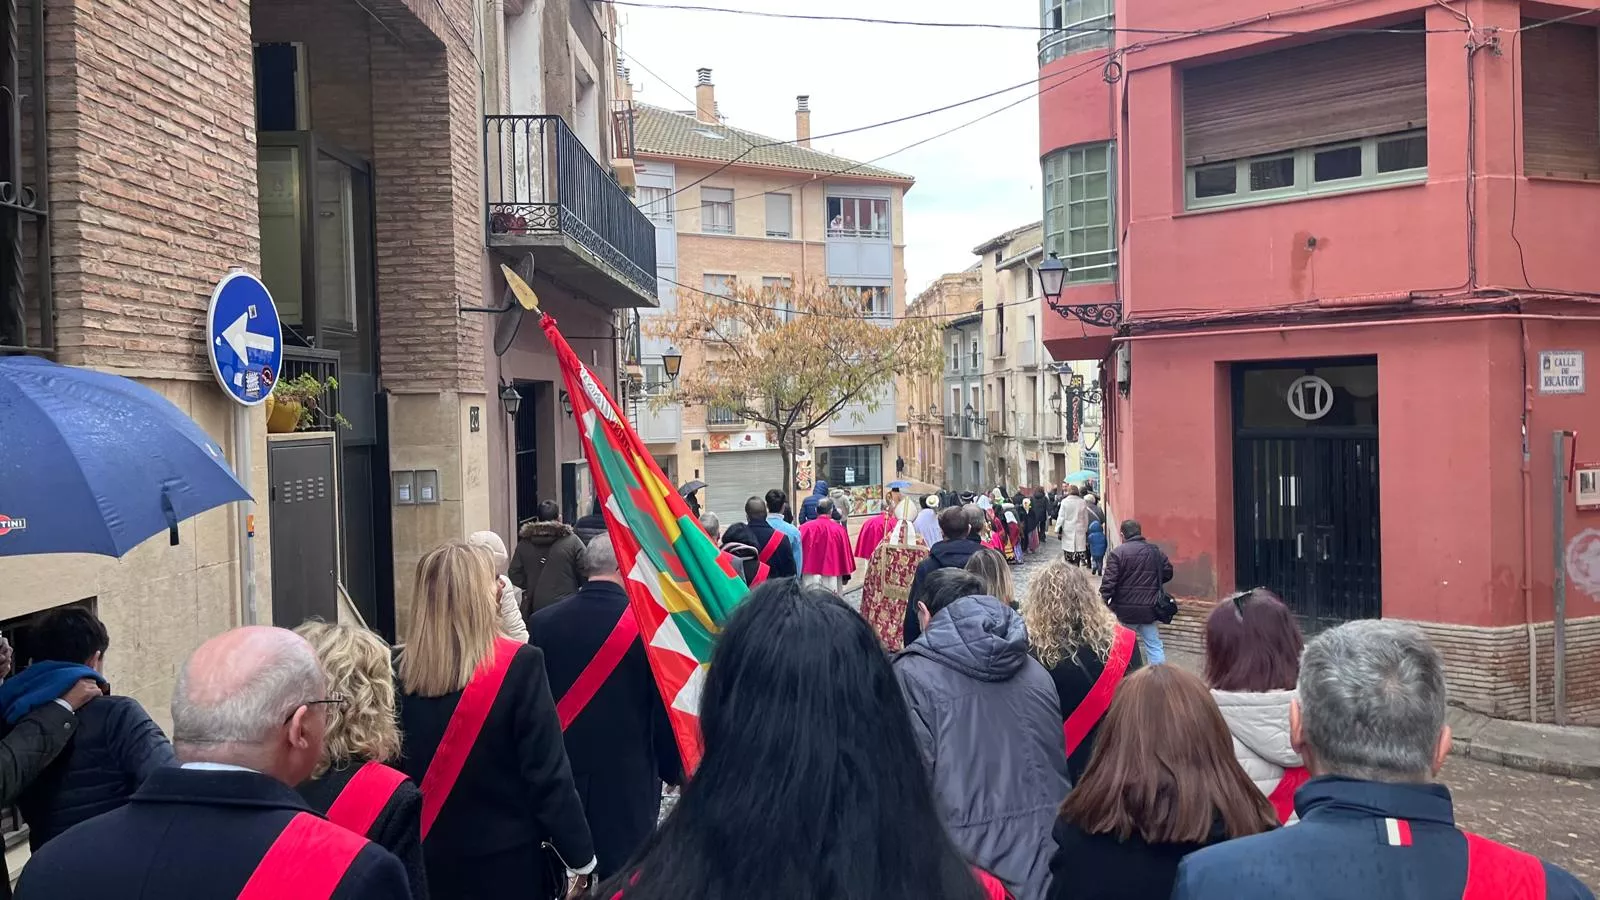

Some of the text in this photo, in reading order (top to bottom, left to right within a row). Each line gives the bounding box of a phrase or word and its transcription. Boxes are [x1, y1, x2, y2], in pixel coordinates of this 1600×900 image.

[1554, 357, 1577, 367] CALLE
[1561, 367, 1570, 375] DE
[1544, 375, 1580, 387] RICAFORT
[1294, 380, 1322, 417] 17
